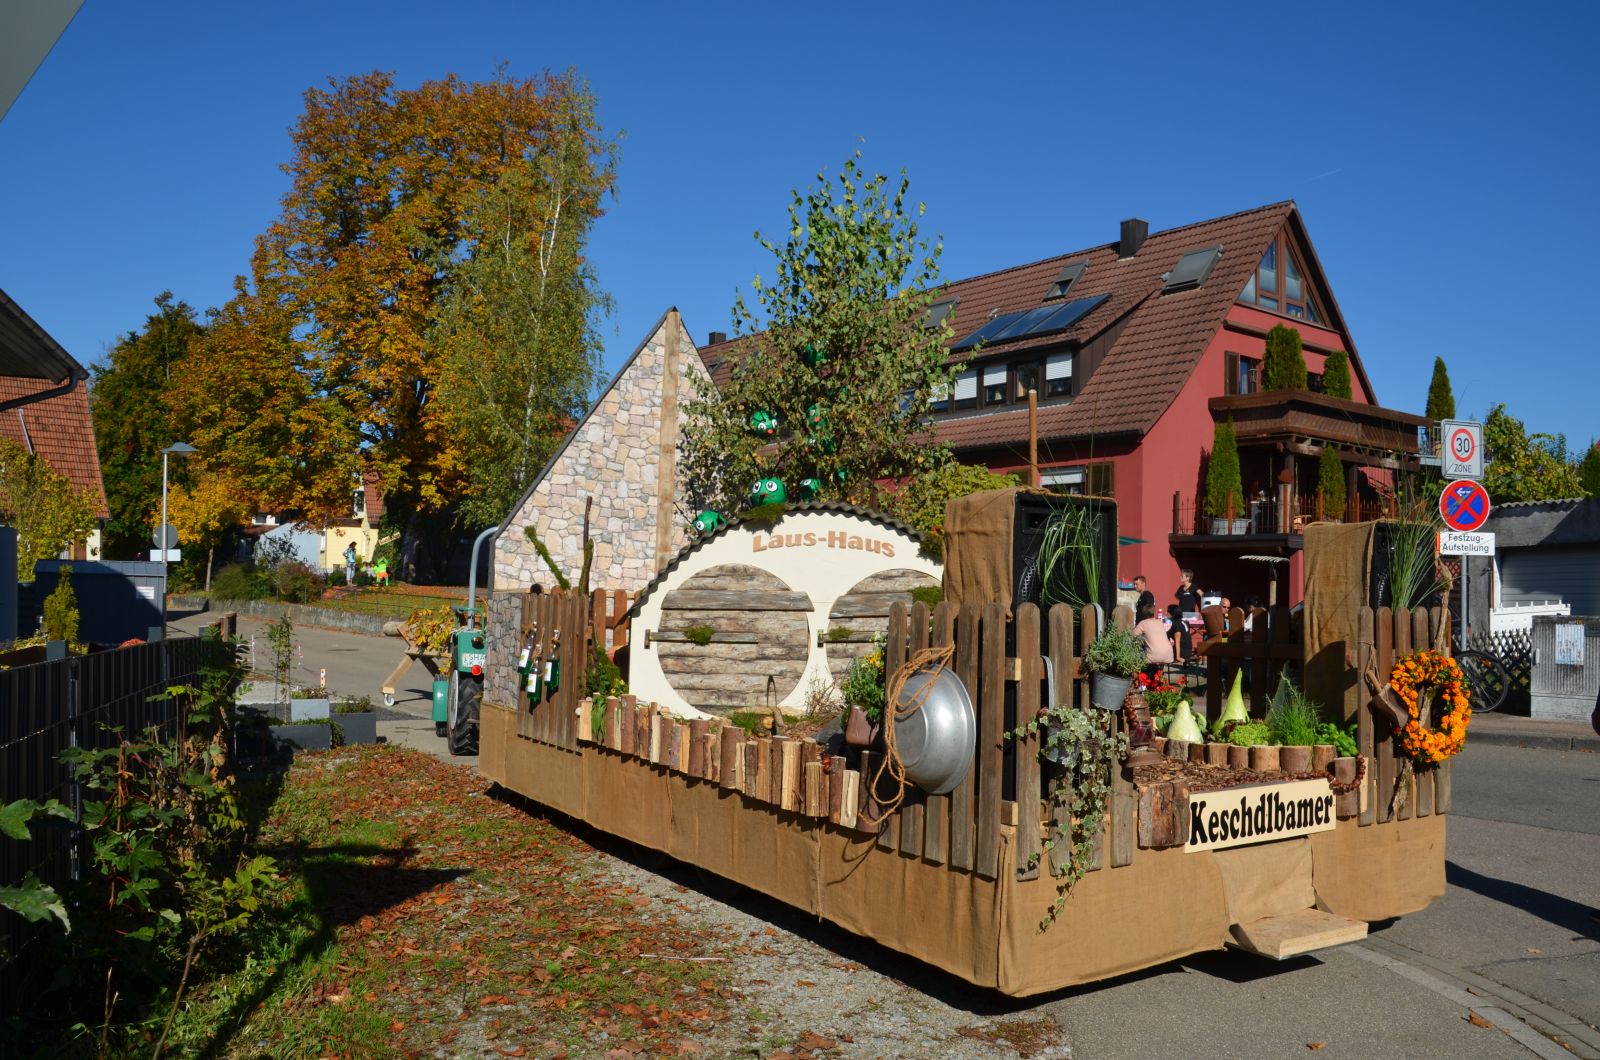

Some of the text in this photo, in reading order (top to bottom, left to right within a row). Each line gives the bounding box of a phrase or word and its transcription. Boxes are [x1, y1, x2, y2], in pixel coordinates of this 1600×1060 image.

[1455, 437, 1470, 453] 30
[1453, 463, 1473, 473] ZONE
[752, 531, 896, 558] Laus-Haus
[1448, 533, 1484, 543] Festzug-
[1442, 543, 1489, 553] Aufstellung
[1190, 791, 1333, 845] Keschdlbamer
